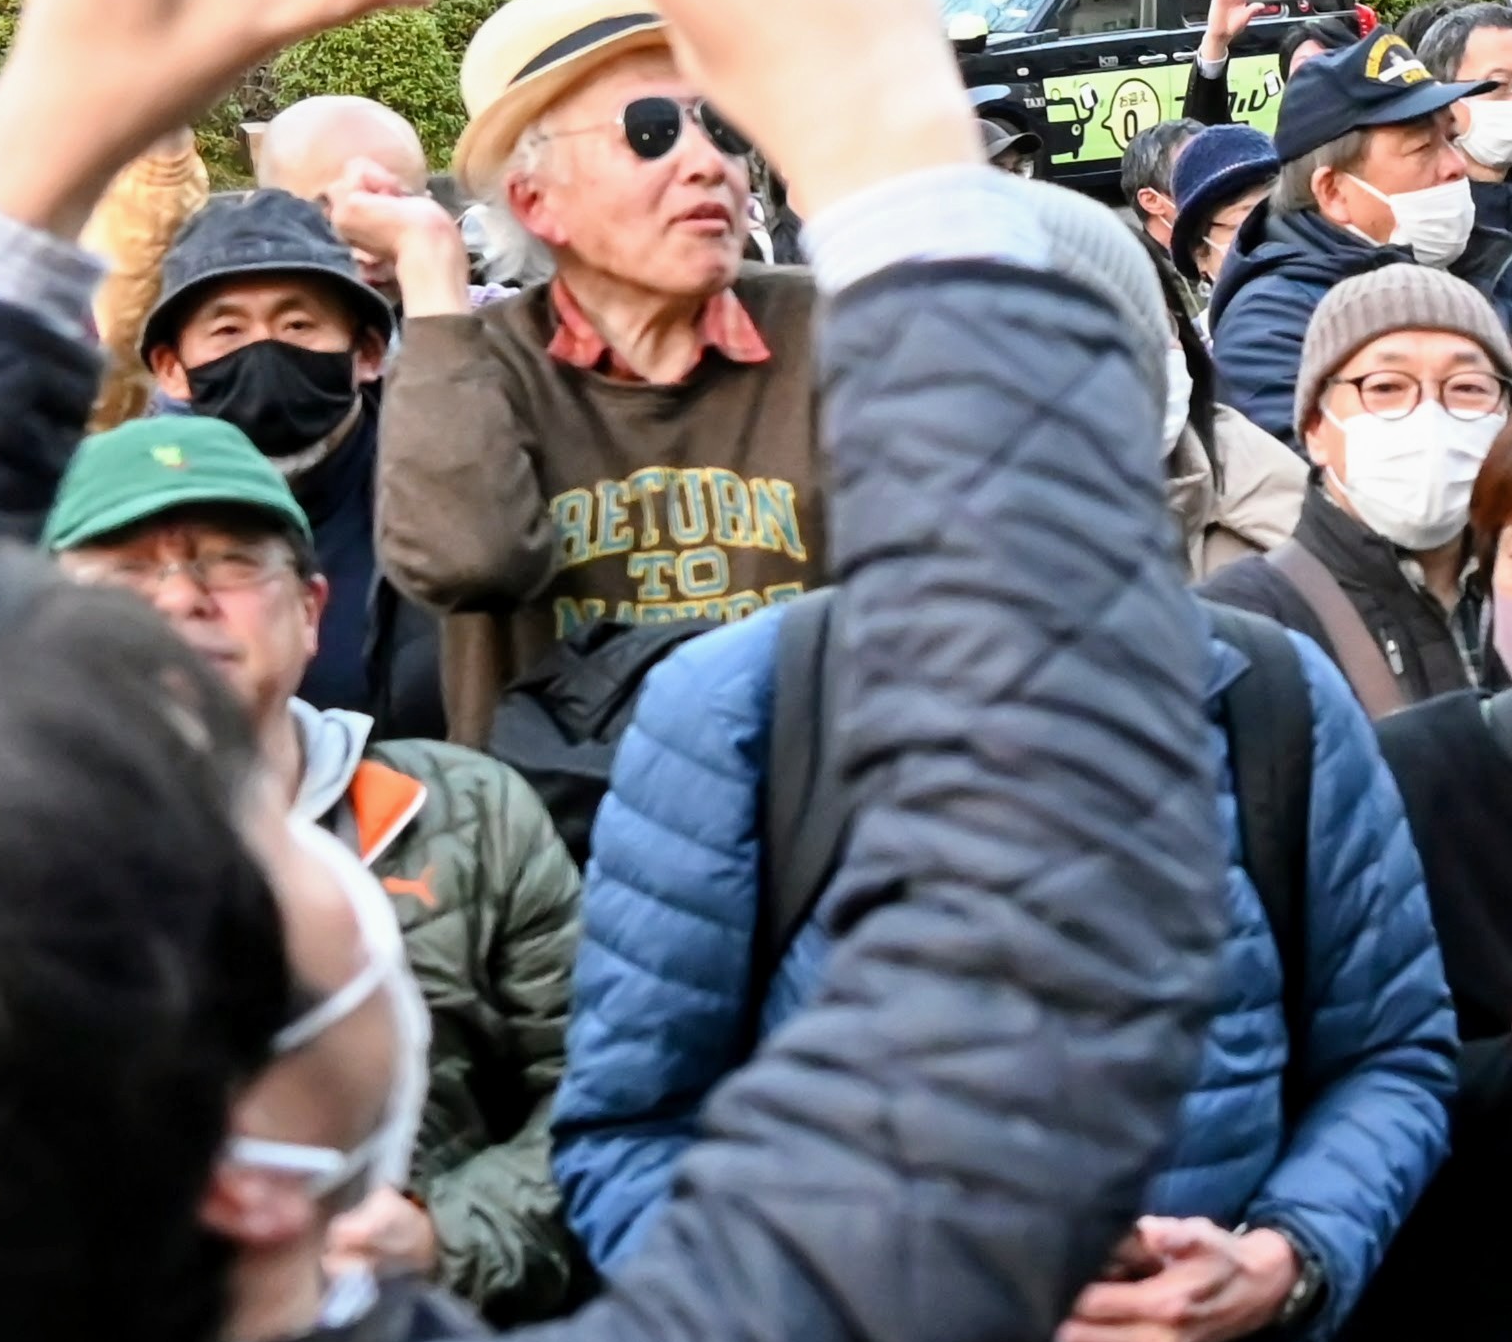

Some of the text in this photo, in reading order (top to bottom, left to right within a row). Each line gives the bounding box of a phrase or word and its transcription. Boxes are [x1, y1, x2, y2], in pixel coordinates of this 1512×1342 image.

[1023, 97, 1046, 109] TAXI
[549, 465, 807, 567] RETURN
[626, 545, 730, 602] TO
